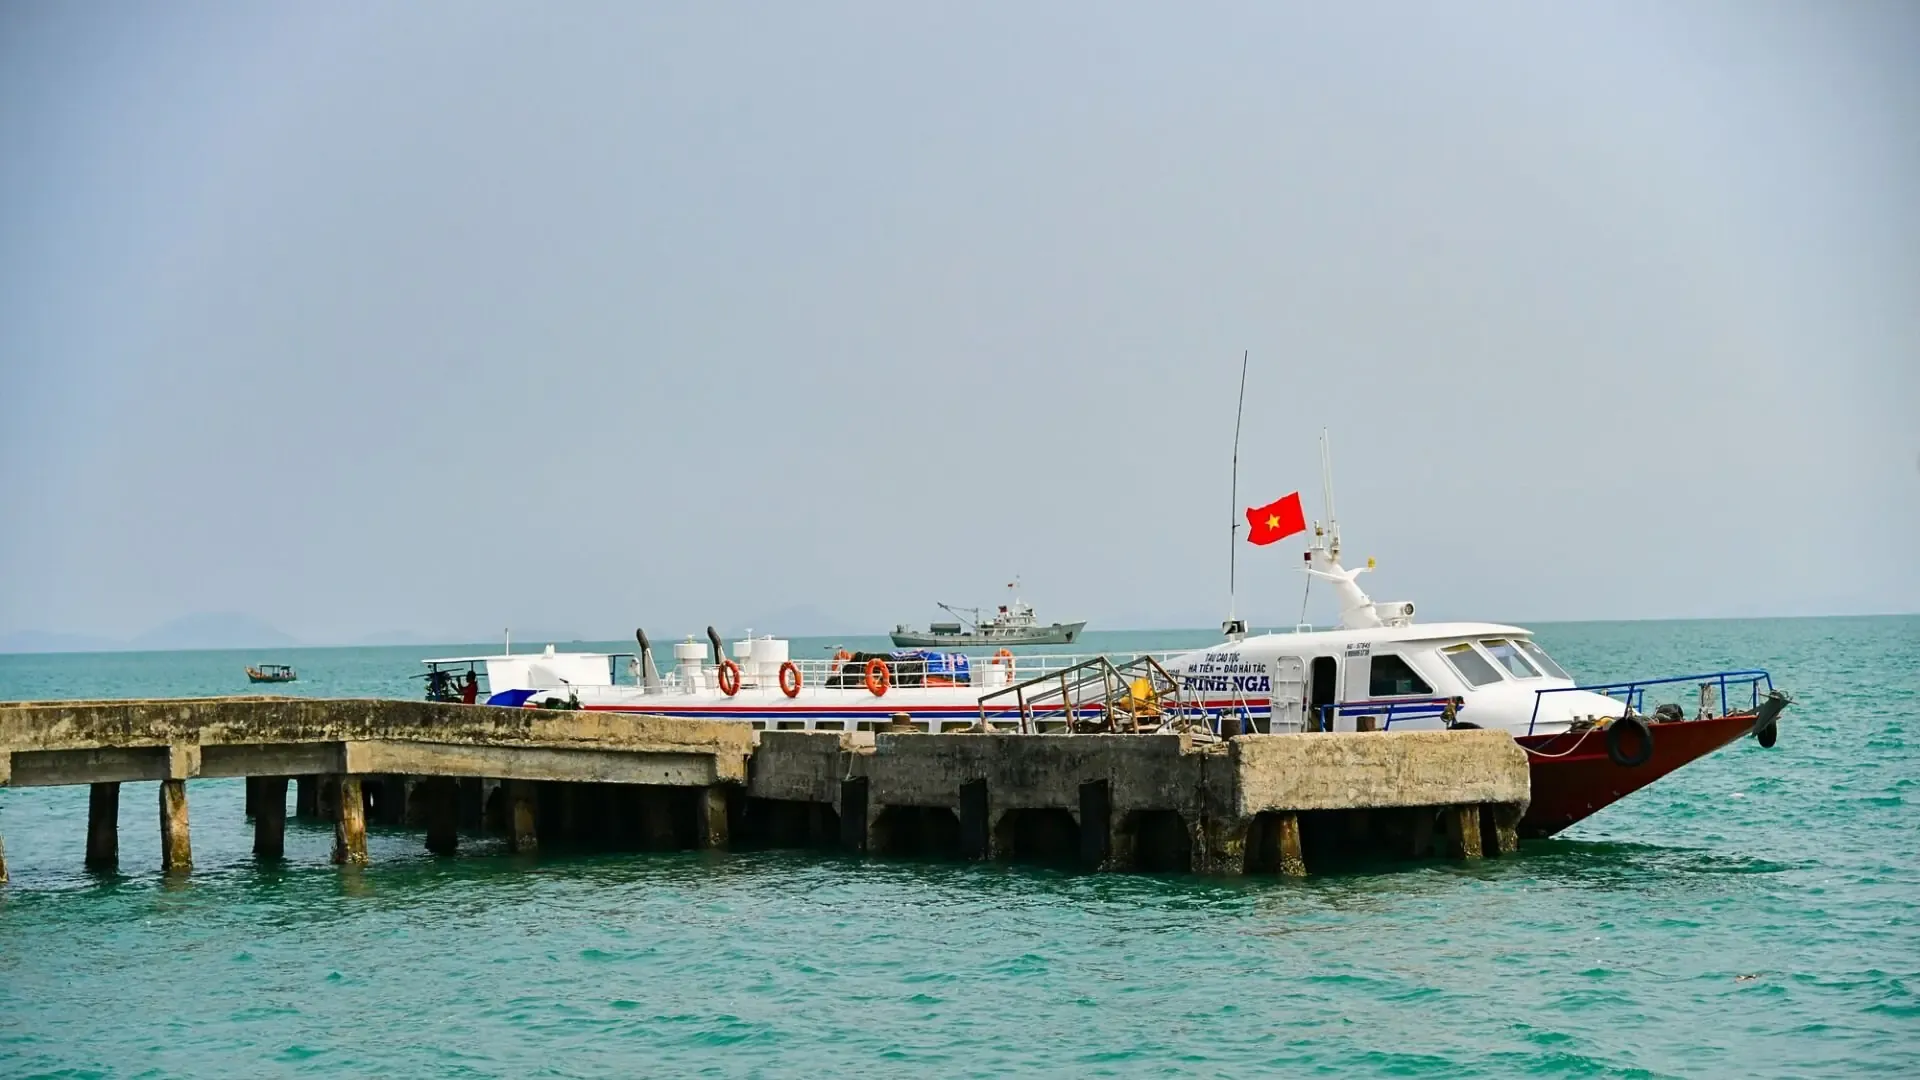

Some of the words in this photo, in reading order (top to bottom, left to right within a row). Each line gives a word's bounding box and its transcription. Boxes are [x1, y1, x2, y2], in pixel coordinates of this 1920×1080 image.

[1216, 652, 1228, 662] CAO
[1183, 675, 1228, 691] MINH
[1231, 675, 1270, 692] NGA
